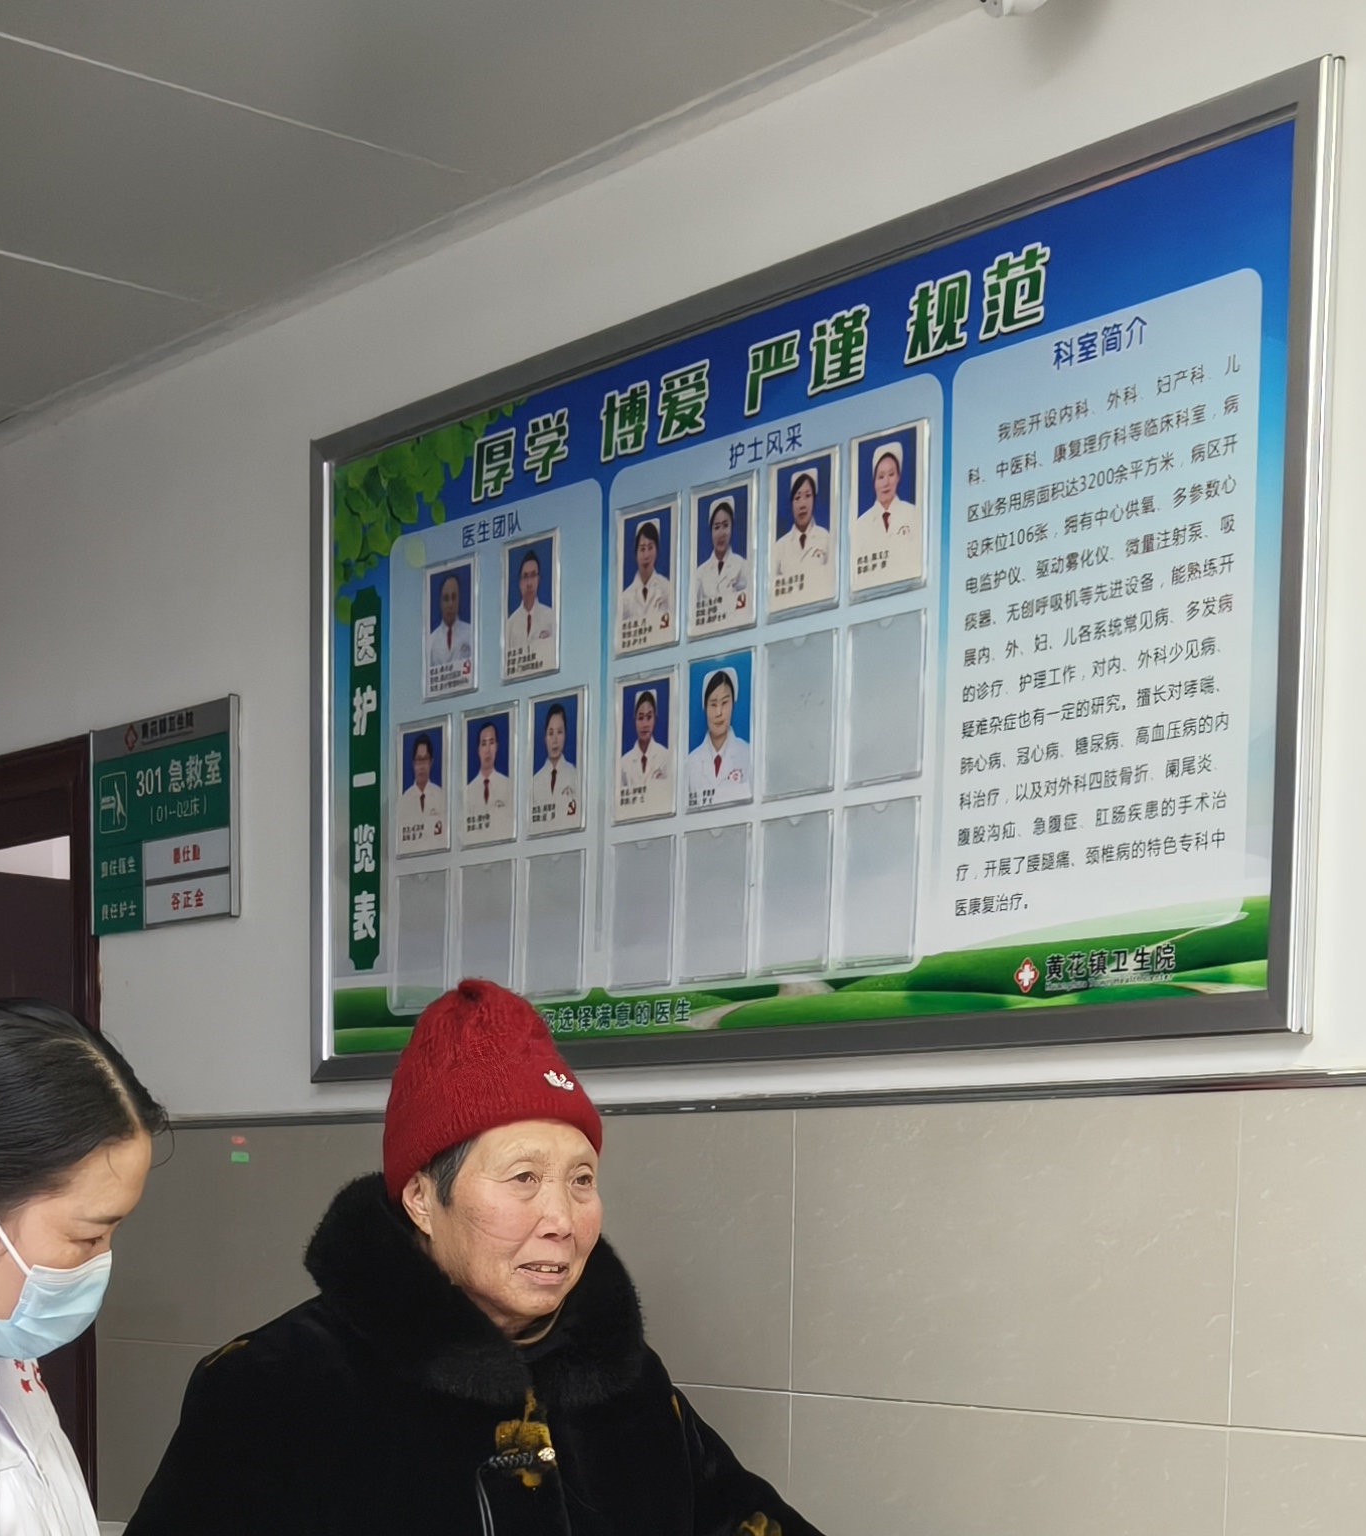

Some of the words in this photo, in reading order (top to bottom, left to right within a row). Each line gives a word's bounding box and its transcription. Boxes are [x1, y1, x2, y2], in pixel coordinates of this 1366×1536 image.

[1053, 316, 1148, 370] 科室简介
[471, 408, 569, 502] 厚学
[601, 359, 709, 462] 博爱
[745, 304, 869, 417] 严谨
[904, 242, 1050, 365] 规范
[729, 423, 802, 469] 护士风采
[462, 510, 521, 548] 医生团队
[136, 766, 162, 797] 301
[168, 750, 222, 793] 急救室
[353, 616, 376, 940] 医护一览表
[1045, 943, 1176, 981] 黄花镇卫生院
